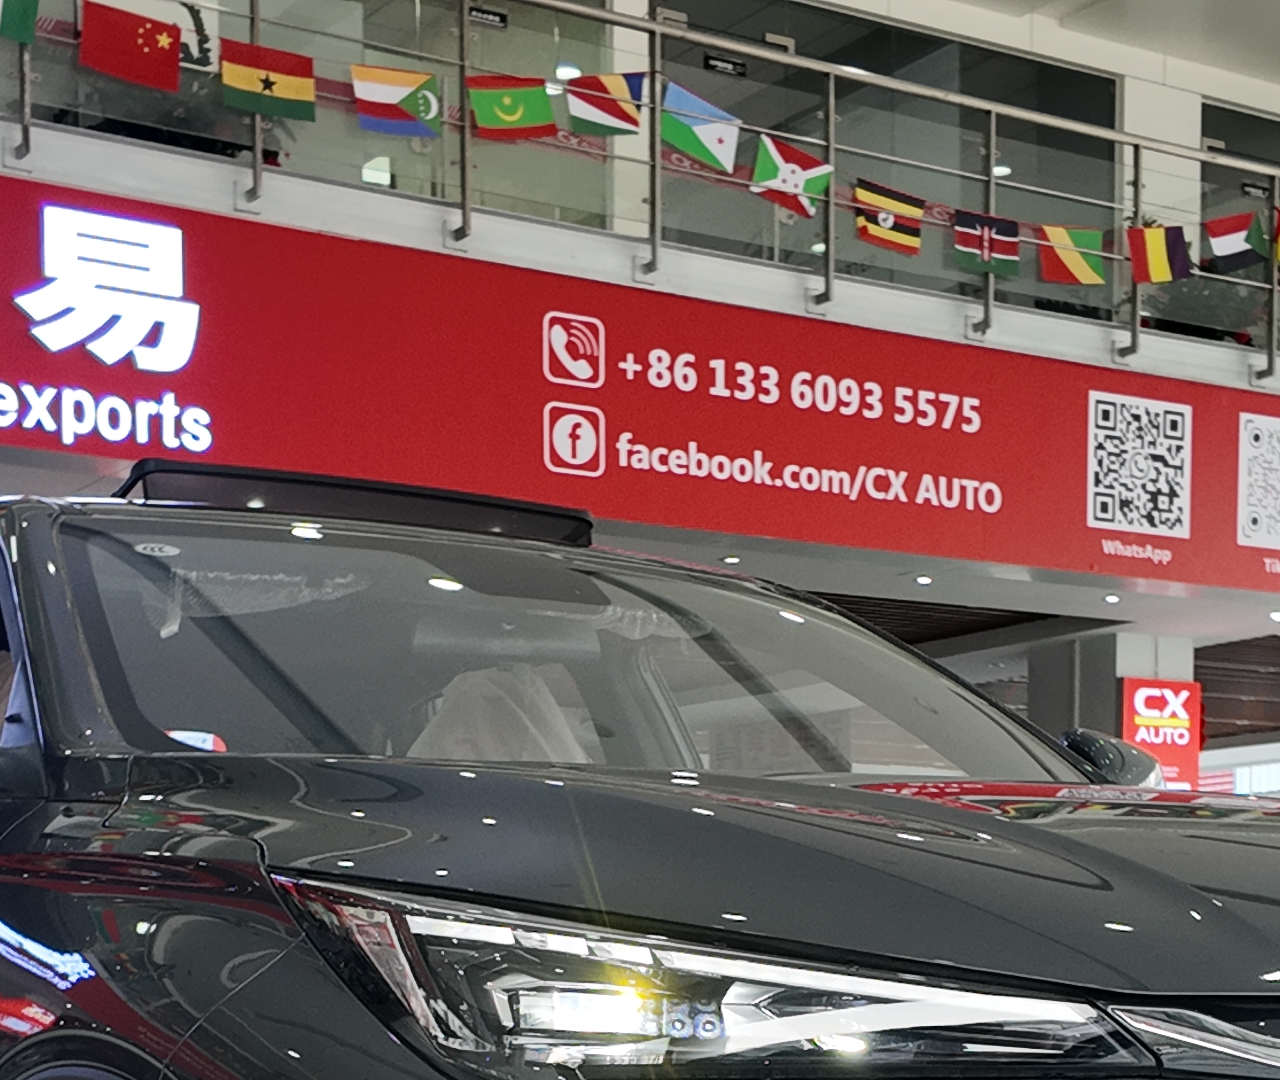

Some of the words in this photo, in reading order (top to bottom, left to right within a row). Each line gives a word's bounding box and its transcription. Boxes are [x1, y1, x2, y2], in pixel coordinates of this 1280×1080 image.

[618, 348, 698, 392] +86
[708, 359, 780, 403] 133
[790, 371, 883, 419] 6093
[893, 386, 981, 433] 5575
[616, 432, 908, 503] facebook.com/CX
[915, 474, 1003, 513] AUTO
[1101, 538, 1172, 565] WhatsApp
[1133, 687, 1191, 720] CX
[1134, 725, 1191, 746] AUTO
